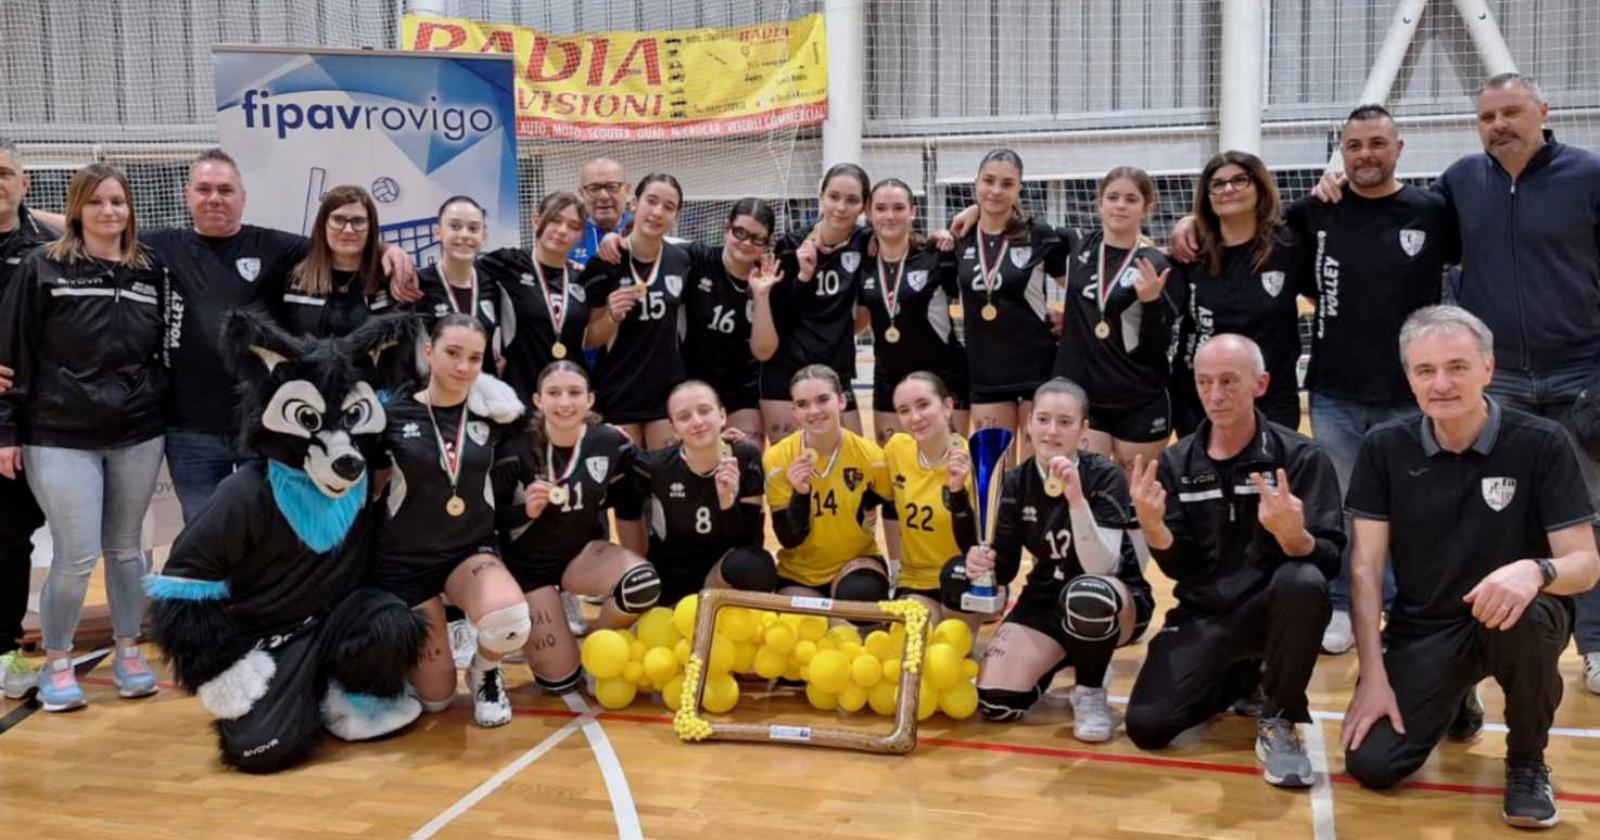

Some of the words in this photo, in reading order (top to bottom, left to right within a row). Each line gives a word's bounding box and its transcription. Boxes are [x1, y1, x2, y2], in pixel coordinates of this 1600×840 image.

[241, 89, 493, 141] fipavrovigo
[815, 269, 840, 296] 10
[1323, 255, 1340, 316] VOLLEY
[170, 290, 184, 348] VOLLEY
[638, 290, 667, 321] 15
[707, 304, 736, 334] 16
[560, 481, 585, 512] 11
[813, 488, 839, 518] 14
[695, 506, 712, 534] 8
[905, 502, 935, 533] 22
